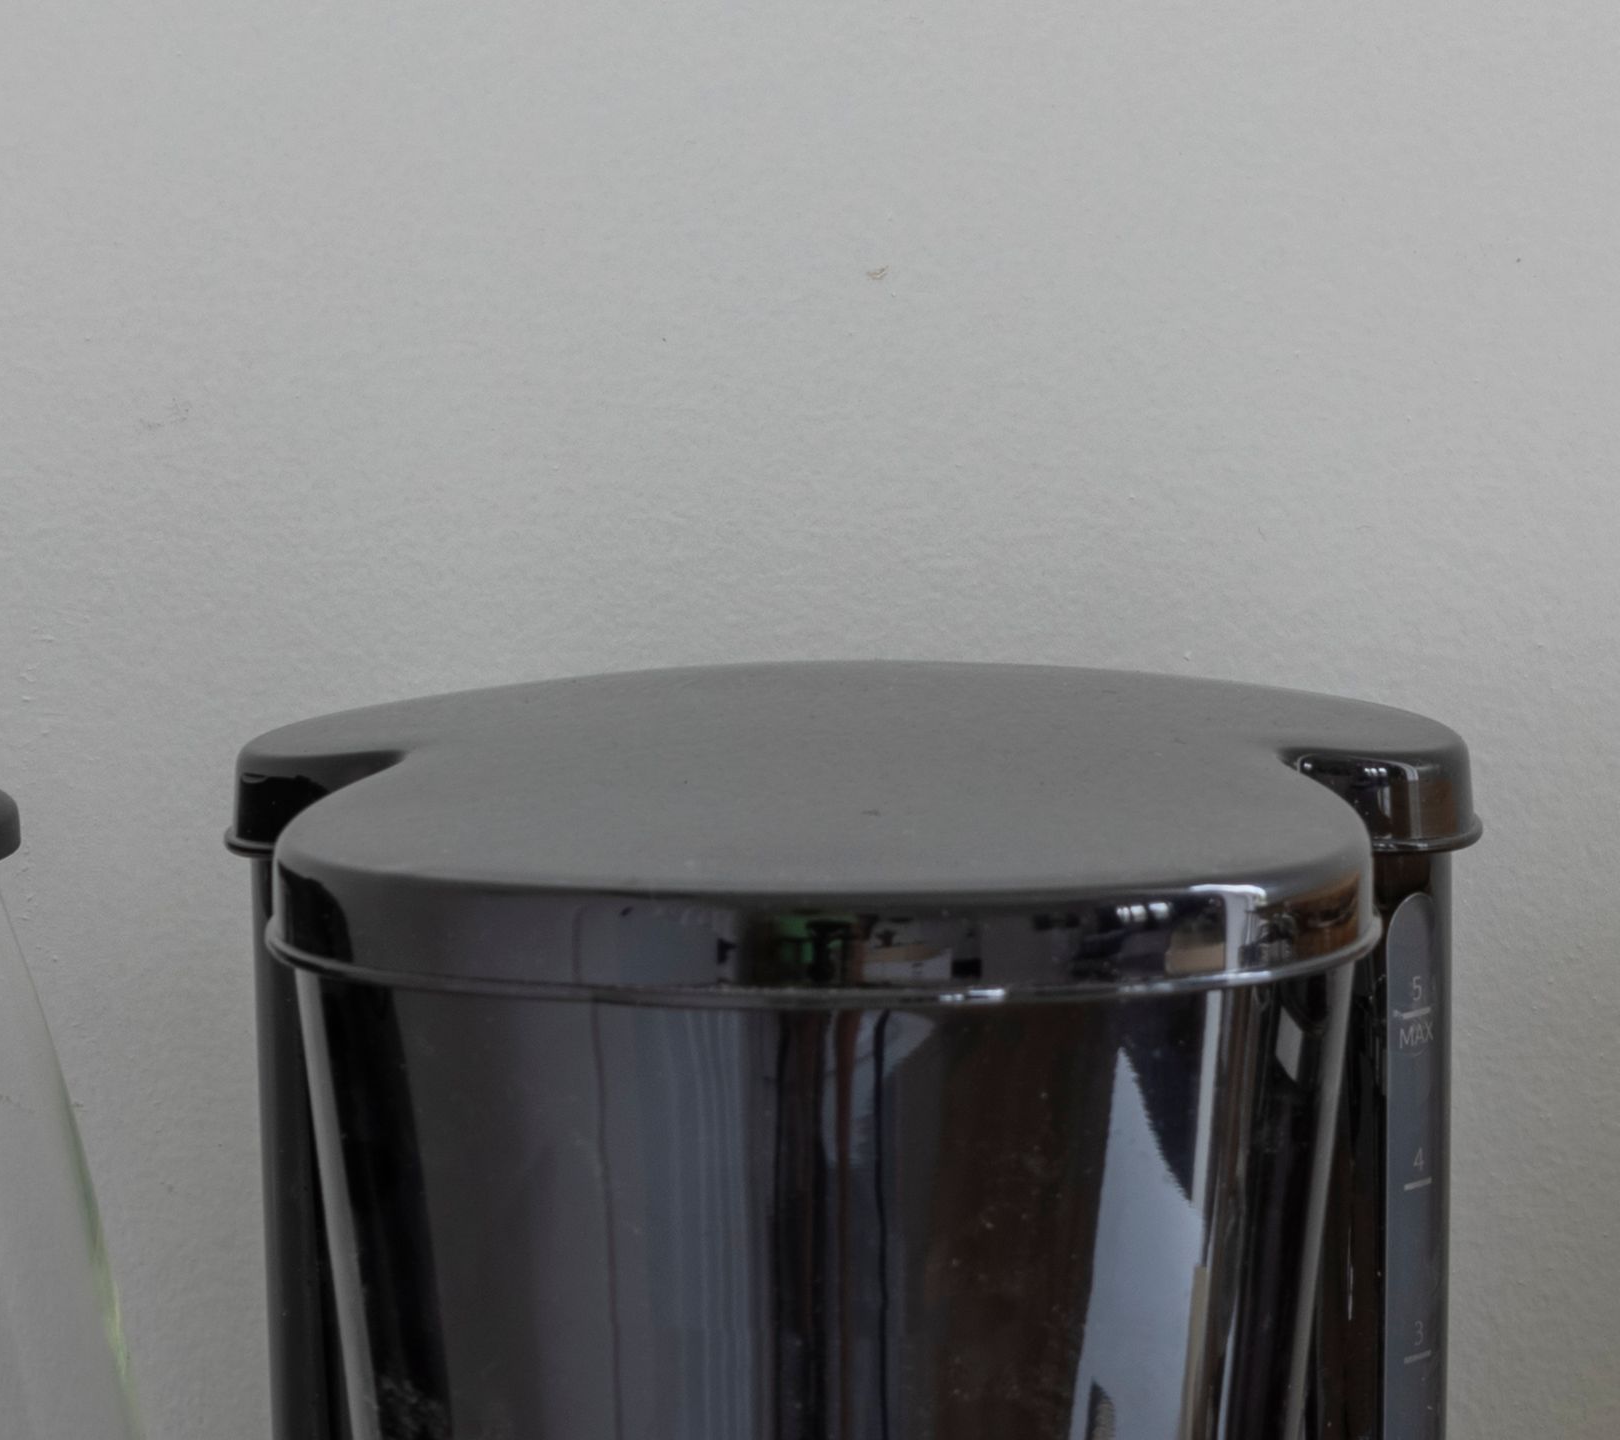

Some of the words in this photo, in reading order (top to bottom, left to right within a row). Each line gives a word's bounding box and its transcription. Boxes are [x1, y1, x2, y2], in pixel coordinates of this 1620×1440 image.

[1412, 975, 1423, 1001] 5
[1399, 1020, 1434, 1049] MAX
[1412, 1147, 1425, 1172] 4
[1414, 1320, 1424, 1346] 3
